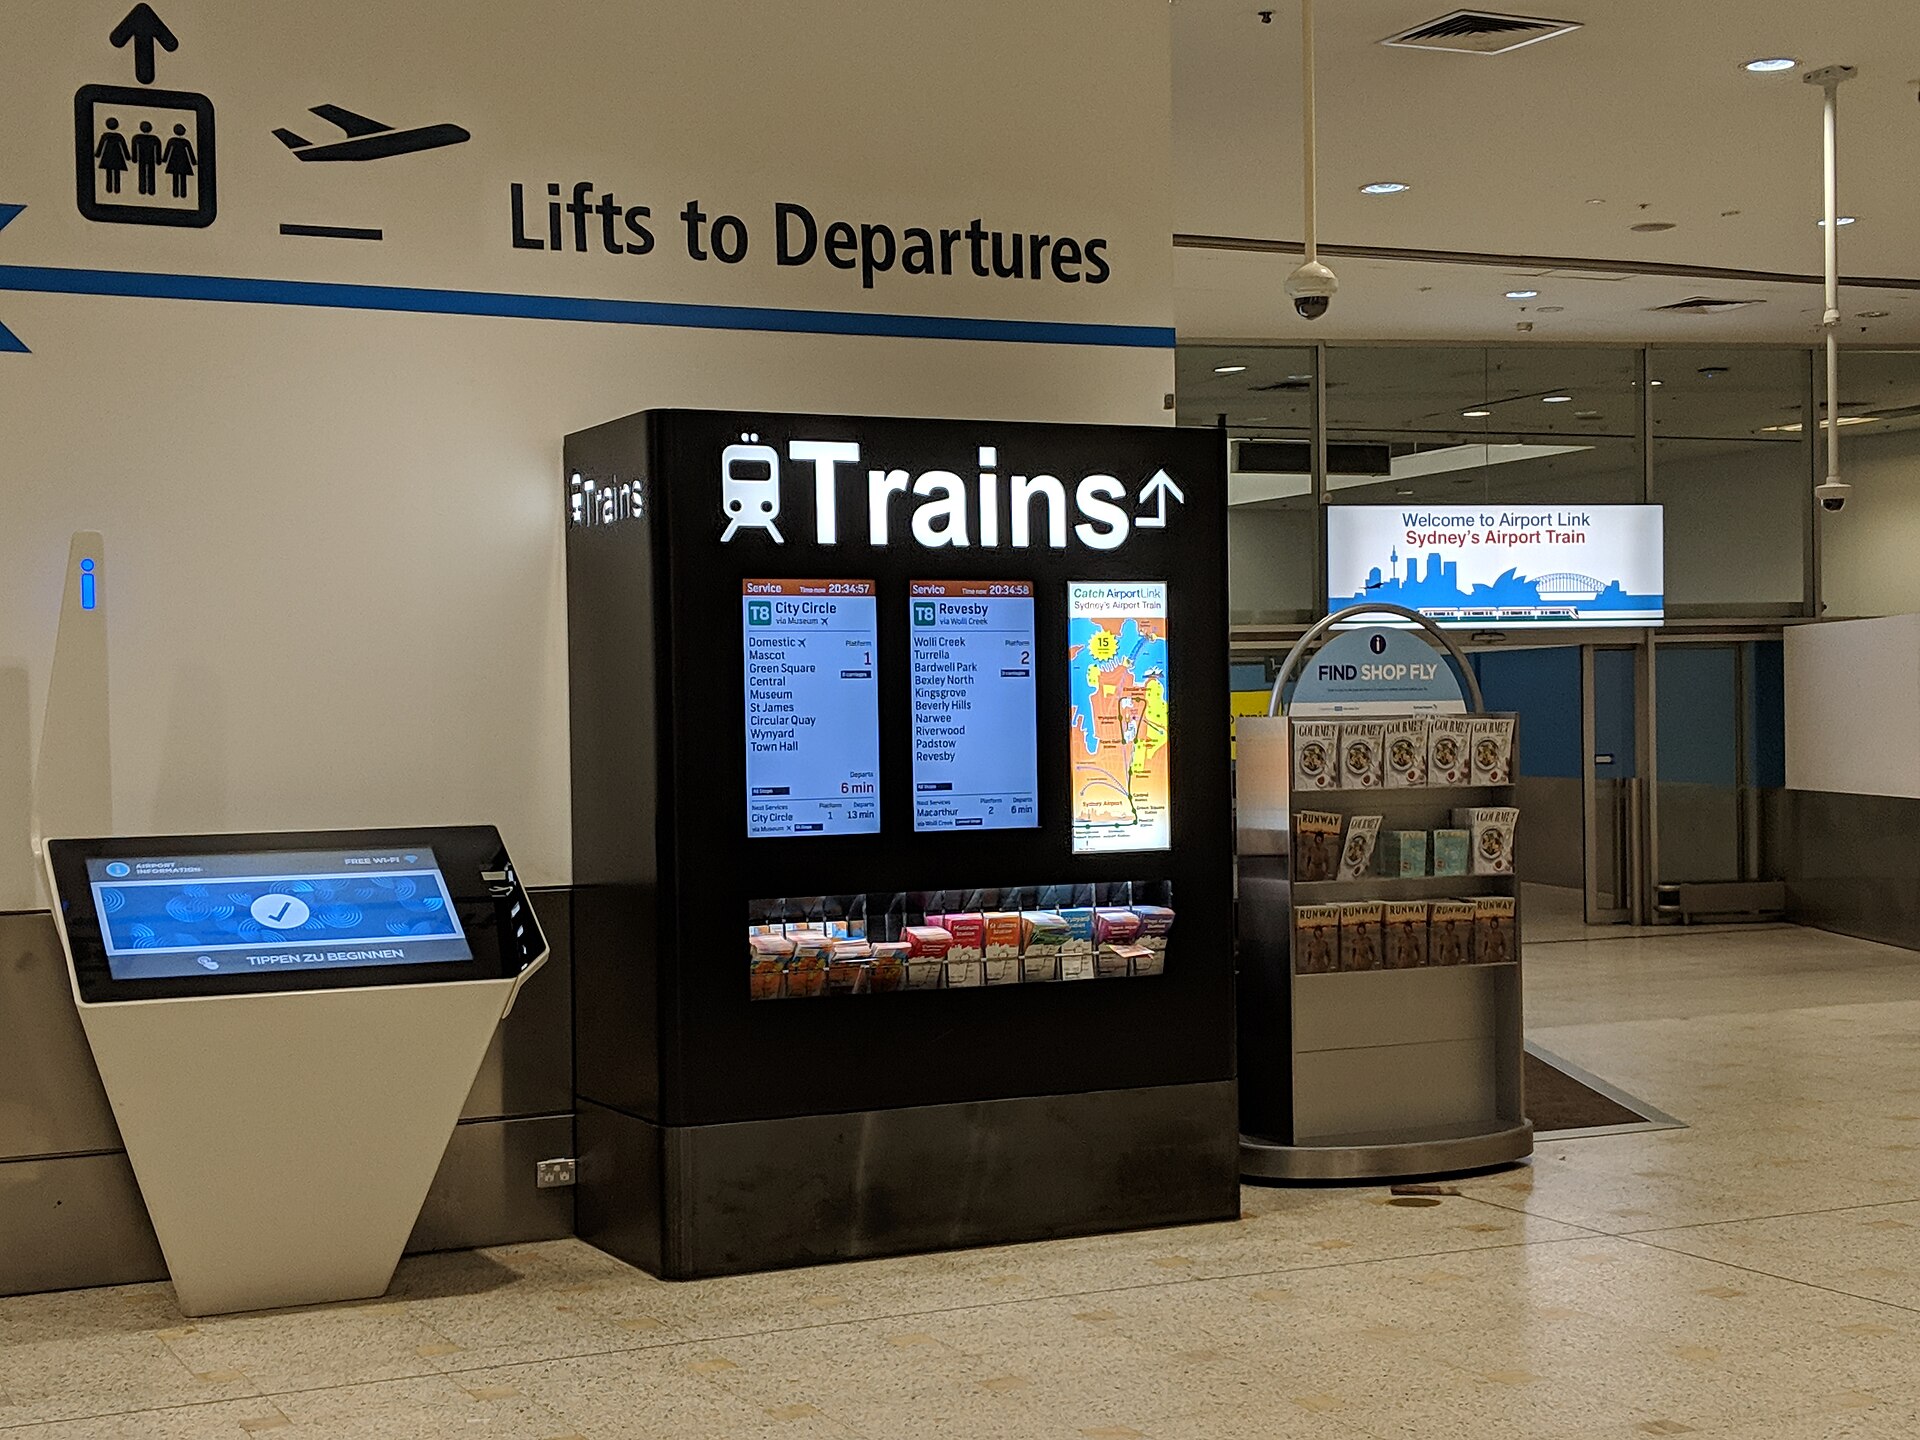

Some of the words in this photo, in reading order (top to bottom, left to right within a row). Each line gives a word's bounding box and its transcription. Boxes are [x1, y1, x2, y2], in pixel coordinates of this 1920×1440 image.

[510, 182, 655, 255] Lifts
[680, 200, 748, 263] to
[775, 202, 1111, 289] Departures
[789, 440, 1131, 550] Trains
[584, 474, 643, 528] Trains
[1403, 512, 1475, 527] Welcome
[1479, 514, 1494, 527] to
[1499, 512, 1553, 530] Airport
[1558, 512, 1591, 527] Link
[1406, 530, 1480, 547] Sydney's
[1485, 529, 1541, 547] Airport
[1545, 529, 1586, 544] Train
[747, 583, 782, 593] Service
[828, 583, 870, 594] 20:34:57
[912, 584, 945, 595] Service
[989, 585, 1030, 595] 20:34:58
[1073, 588, 1105, 598] Catch
[750, 606, 770, 621] T8
[775, 601, 800, 616] City
[802, 601, 837, 614] Circle
[915, 607, 934, 621] T8
[939, 602, 989, 617] Revesby
[1074, 601, 1110, 611] Sydney's
[1112, 601, 1140, 610] Airport
[1142, 601, 1162, 609] Train
[749, 637, 796, 647] Domestic
[914, 637, 937, 647] Wolli
[939, 637, 966, 647] Creek
[1097, 637, 1109, 647] 15
[749, 650, 785, 660] Mascot
[863, 651, 872, 665] 1
[914, 650, 950, 660] Turrella
[1021, 651, 1030, 665] 2
[749, 663, 779, 673] Green
[781, 663, 816, 675] Square
[914, 662, 955, 673] Bardwell
[956, 662, 978, 672] Park
[1318, 665, 1358, 681] FIND
[1360, 664, 1407, 681] SHOP
[1410, 664, 1438, 681] FLY
[749, 676, 786, 686] Central
[915, 675, 946, 687] Bexley
[947, 675, 974, 685] North
[750, 689, 793, 700] Museum
[915, 688, 967, 699] Kingsgrove
[750, 703, 761, 713] St
[763, 703, 794, 713] James
[915, 700, 950, 712] Beverly
[951, 700, 972, 710] Hills
[750, 716, 789, 726] Circular
[791, 715, 816, 727] Quay
[915, 713, 952, 723] Narwee
[750, 728, 795, 740] Wynyard
[916, 725, 966, 735] Riverwood
[750, 742, 778, 752] Town
[780, 741, 799, 752] Hall
[916, 739, 957, 748] Padstow
[916, 751, 956, 762] Revesby
[841, 782, 849, 794] 6
[851, 781, 874, 794] min
[847, 810, 858, 819] 13
[859, 810, 875, 819] min
[917, 807, 959, 817] Macarthur
[988, 806, 994, 815] 2
[1017, 805, 1033, 814] min
[751, 813, 768, 824] City
[769, 812, 793, 822] Circle
[827, 811, 833, 820] 1
[1302, 813, 1339, 826] RUNWAY
[1343, 905, 1381, 917] RUNWAY
[1389, 905, 1426, 915] RUNWAY
[1435, 905, 1474, 915] RUNWAY
[1477, 900, 1513, 911] RUNWAY
[1300, 909, 1339, 919] RUNWAY
[246, 954, 300, 966] TIPPEN
[303, 953, 325, 962] ZU
[326, 949, 404, 962] BEGINNEN
